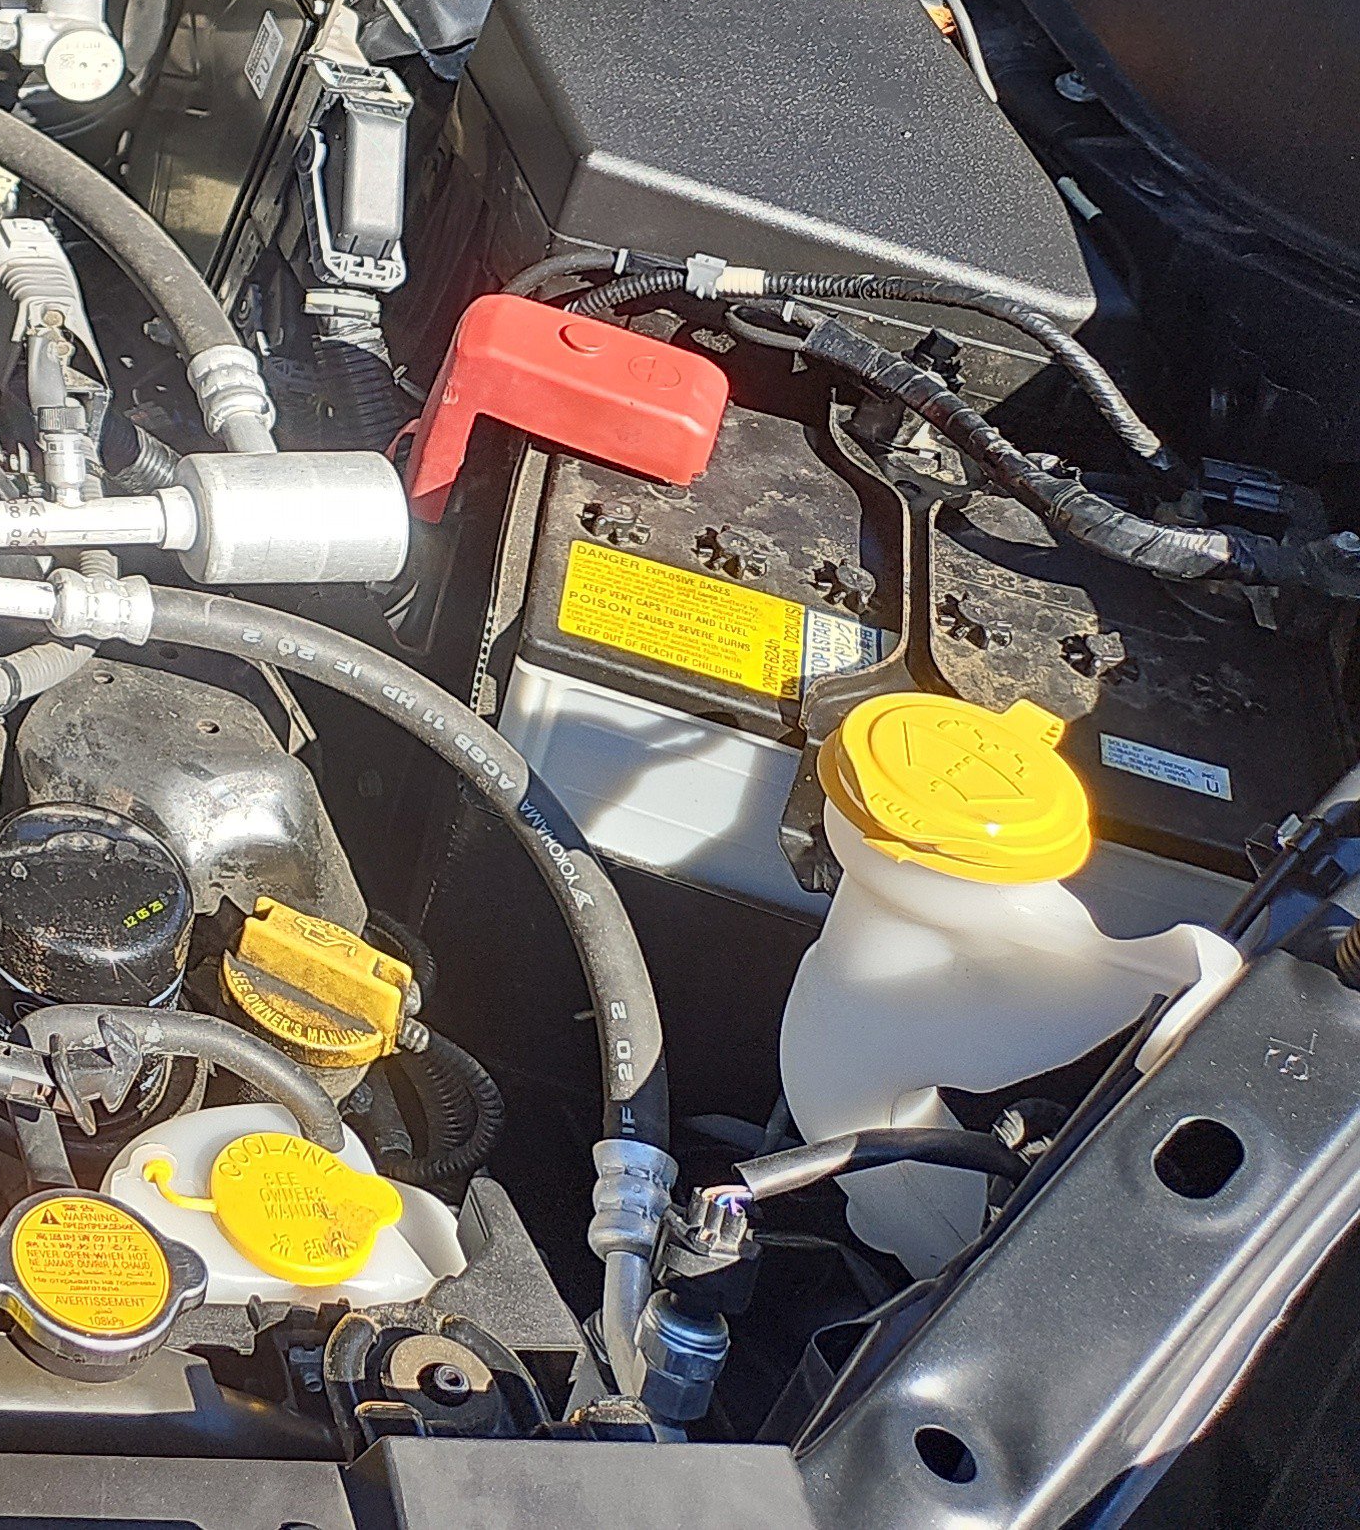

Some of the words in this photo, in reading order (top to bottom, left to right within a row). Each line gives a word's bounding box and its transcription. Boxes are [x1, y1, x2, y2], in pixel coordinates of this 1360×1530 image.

[576, 544, 639, 570] DANGER
[645, 565, 694, 586] EXPLOSIVE
[699, 580, 730, 596] GASES
[568, 590, 631, 616] POISON
[636, 611, 674, 629] CAUSES
[678, 623, 714, 641] SEVERE
[717, 635, 750, 651] BURNS
[582, 582, 606, 596] KEEP
[608, 589, 632, 603] VENT
[635, 597, 660, 611] CAPS
[664, 605, 691, 620] TIGHT
[695, 614, 715, 627] AND
[718, 621, 748, 637] LEVEL
[242, 628, 262, 643] 2
[277, 637, 316, 661] 20
[575, 623, 600, 637] KEEP
[602, 631, 622, 644] OUT
[624, 637, 638, 648] OF
[640, 642, 673, 659] REACH
[675, 652, 688, 663] OF
[692, 657, 742, 679] CHILDREN
[765, 638, 780, 663] 62Ah
[382, 684, 418, 710] HP
[422, 708, 445, 731] 11
[1205, 779, 1219, 794] U
[520, 798, 580, 886] YOKOHAMA
[123, 915, 138, 929] 12
[231, 970, 254, 993] SEE
[244, 993, 302, 1037] OWNER'S
[307, 1026, 368, 1046] MANUAL
[610, 1000, 627, 1020] 2
[616, 1040, 634, 1082] 20
[218, 1135, 344, 1178] COOLANT
[263, 1171, 300, 1187] SEE
[61, 1212, 118, 1222] WARNING
[264, 1202, 337, 1220] MANUAL
[26, 1250, 59, 1258] NEVER
[63, 1250, 89, 1258] OPEN
[94, 1251, 124, 1259] WHEN
[29, 1258, 40, 1266] NE
[44, 1259, 73, 1267] JAMAIS
[77, 1260, 108, 1268] OUVRIR
[55, 1295, 145, 1307] AVERTISSEMENT
[88, 1316, 124, 1326] 108kPa
